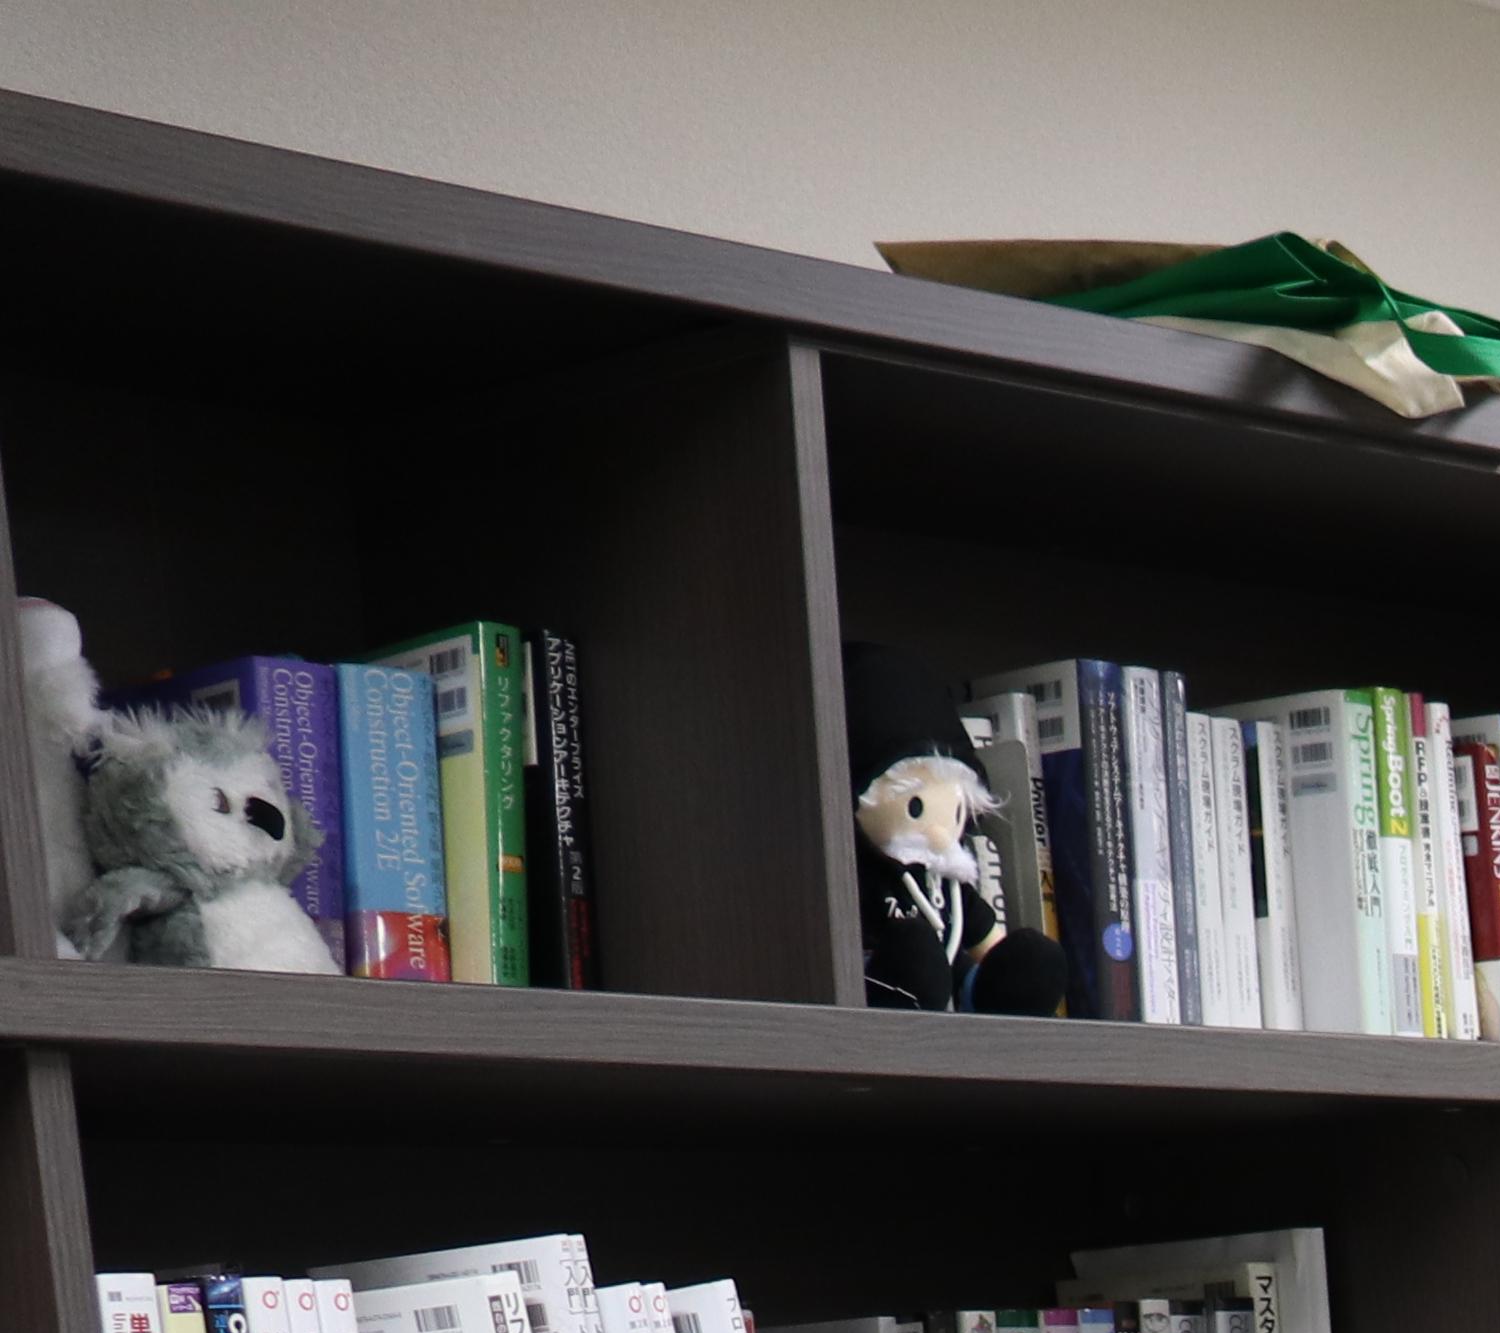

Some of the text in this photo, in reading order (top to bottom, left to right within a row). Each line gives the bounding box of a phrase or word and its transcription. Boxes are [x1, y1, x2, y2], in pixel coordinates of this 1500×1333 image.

[362, 668, 395, 822] Construction
[1197, 721, 1215, 852] スクラム現場ガイド
[1228, 726, 1246, 857] スクラム現場ガイド
